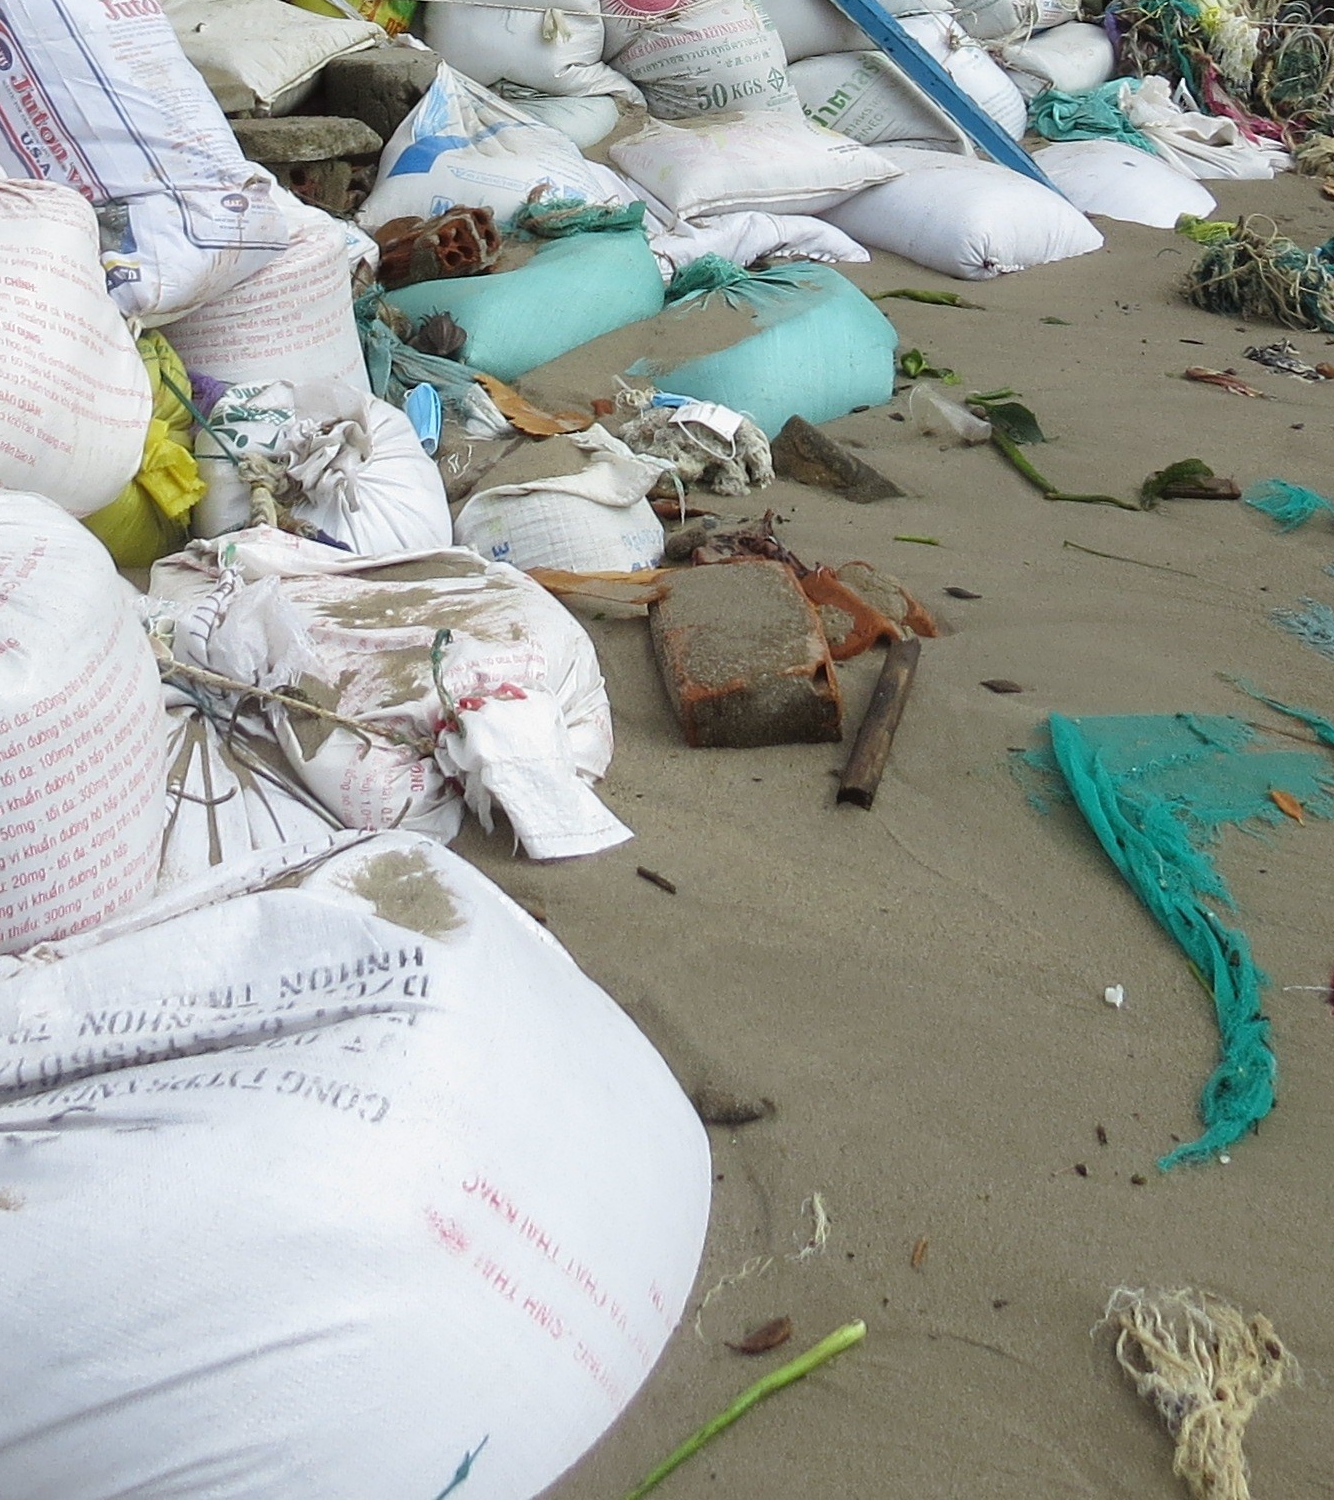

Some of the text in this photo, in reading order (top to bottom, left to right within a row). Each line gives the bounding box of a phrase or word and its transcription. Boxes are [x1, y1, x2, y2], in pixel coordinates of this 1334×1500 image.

[695, 79, 767, 111] 50 KGS.
[12, 869, 46, 889] 20mg
